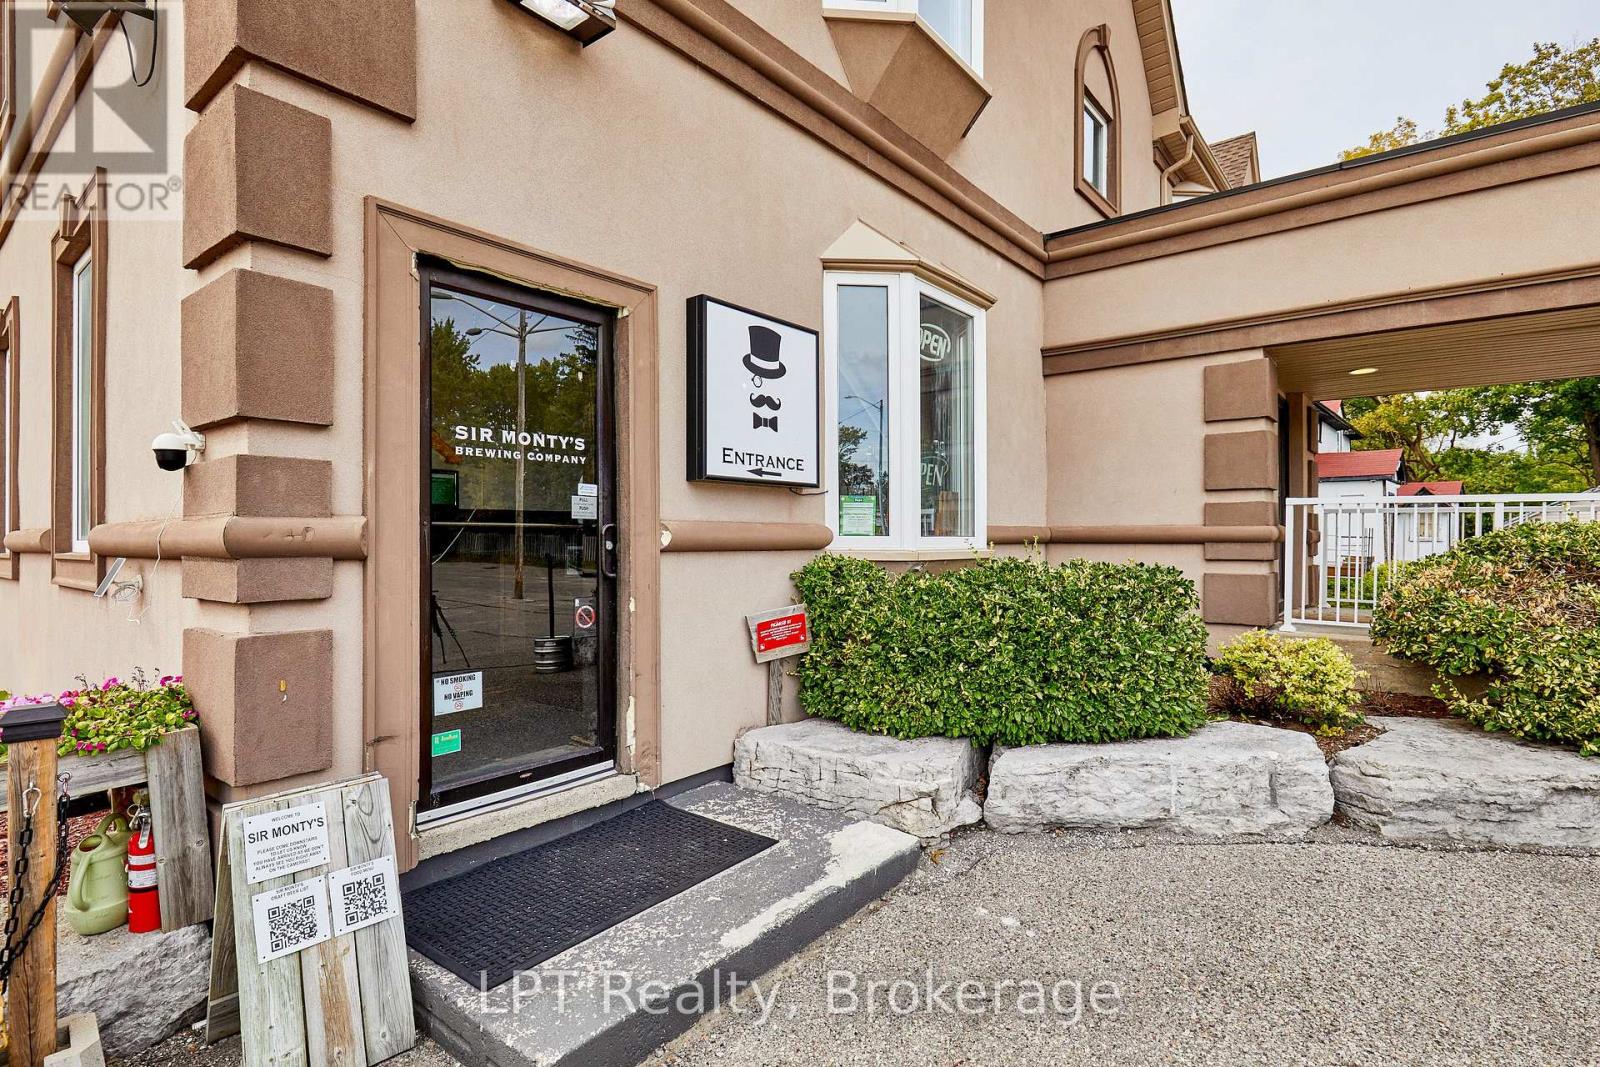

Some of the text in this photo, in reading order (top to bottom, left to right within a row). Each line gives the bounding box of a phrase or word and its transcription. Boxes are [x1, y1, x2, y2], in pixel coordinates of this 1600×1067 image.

[454, 425, 586, 451] SIR MONTY'S
[455, 446, 587, 465] BREWING COMPANY
[722, 447, 804, 471] ENTRANCE
[450, 674, 476, 684] SMOKING
[453, 689, 474, 699] VAPING
[272, 813, 293, 822] WELCOME
[248, 817, 324, 844] SIR MONTY'S
[257, 836, 318, 855] PLEASE COME DOWNSTAIRS
[256, 863, 275, 871] ALWAYS
[309, 850, 322, 858] AWAY
[277, 852, 296, 861] ARRIVED
